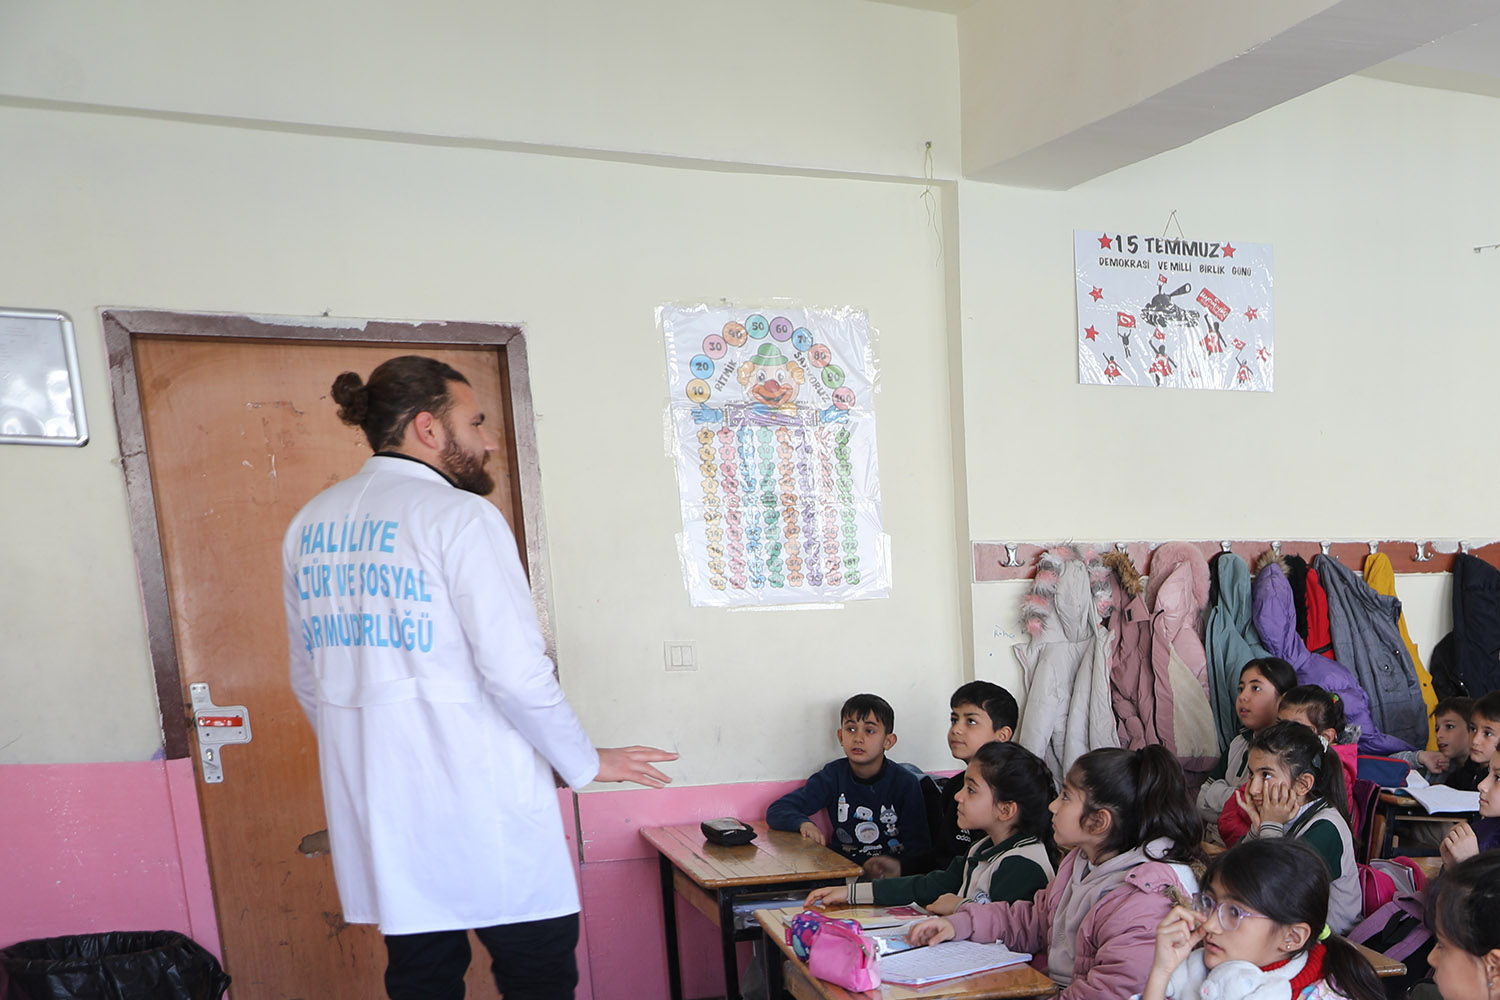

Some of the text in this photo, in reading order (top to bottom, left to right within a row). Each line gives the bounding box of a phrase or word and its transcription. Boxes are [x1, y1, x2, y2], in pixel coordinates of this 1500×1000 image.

[1116, 234, 1220, 258] 15 TEMMUZ
[1099, 257, 1150, 269] DEMOKRASİ
[1158, 261, 1168, 271] VE
[1170, 262, 1192, 272] MİLLİ
[1199, 264, 1225, 274] BİRLİK
[752, 322, 765, 331] 50
[776, 324, 788, 333] 60
[728, 329, 743, 339] 40
[709, 342, 722, 351] 30
[814, 351, 827, 360] 80
[695, 362, 709, 371] 20
[714, 359, 737, 392] RİTMİK
[794, 352, 831, 403] SAYYORUZ
[827, 372, 840, 381] 90
[692, 386, 704, 395] 10
[299, 513, 399, 557] HALİLİYE
[335, 563, 356, 597] VE
[360, 562, 433, 603] SOSYAL
